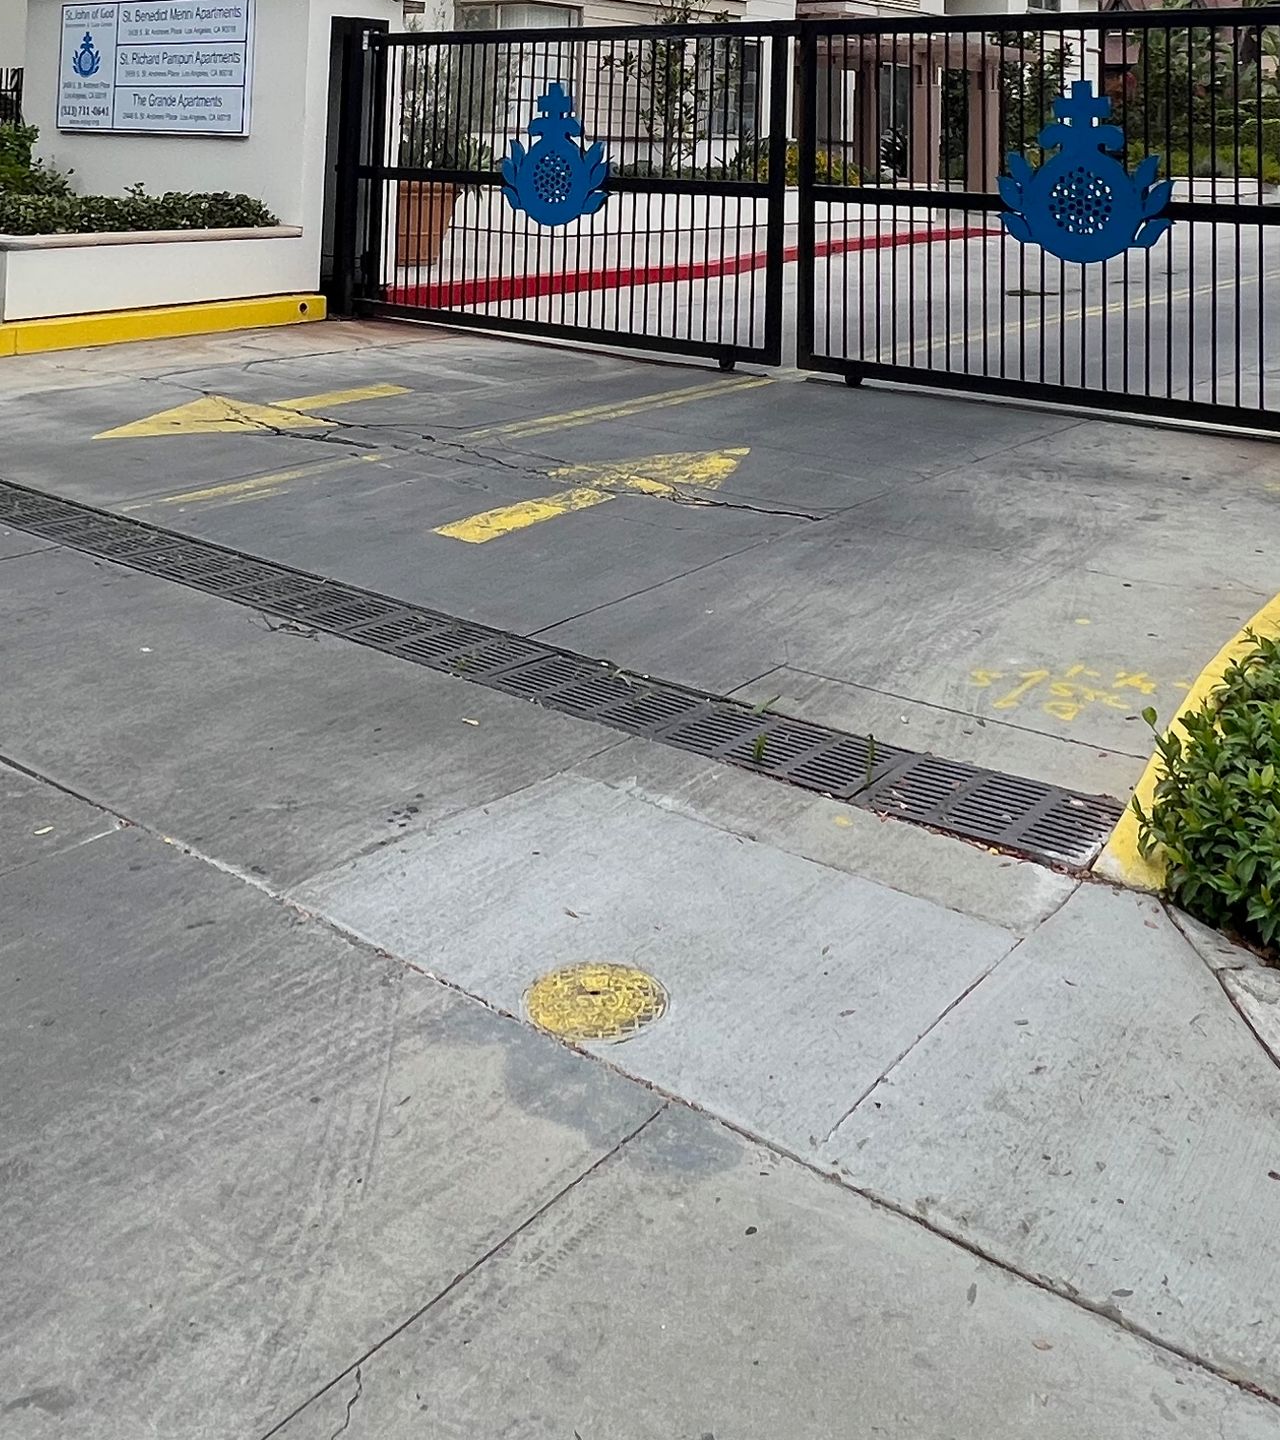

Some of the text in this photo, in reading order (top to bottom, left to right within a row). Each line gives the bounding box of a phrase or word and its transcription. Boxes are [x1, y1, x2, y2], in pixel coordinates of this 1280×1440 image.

[91, 9, 100, 19] of
[100, 8, 114, 19] God
[135, 9, 168, 22] Benedict
[195, 6, 242, 21] Apartments
[131, 52, 160, 65] Richard
[194, 50, 241, 66] Apartments
[132, 93, 223, 109] The Grande Apartments
